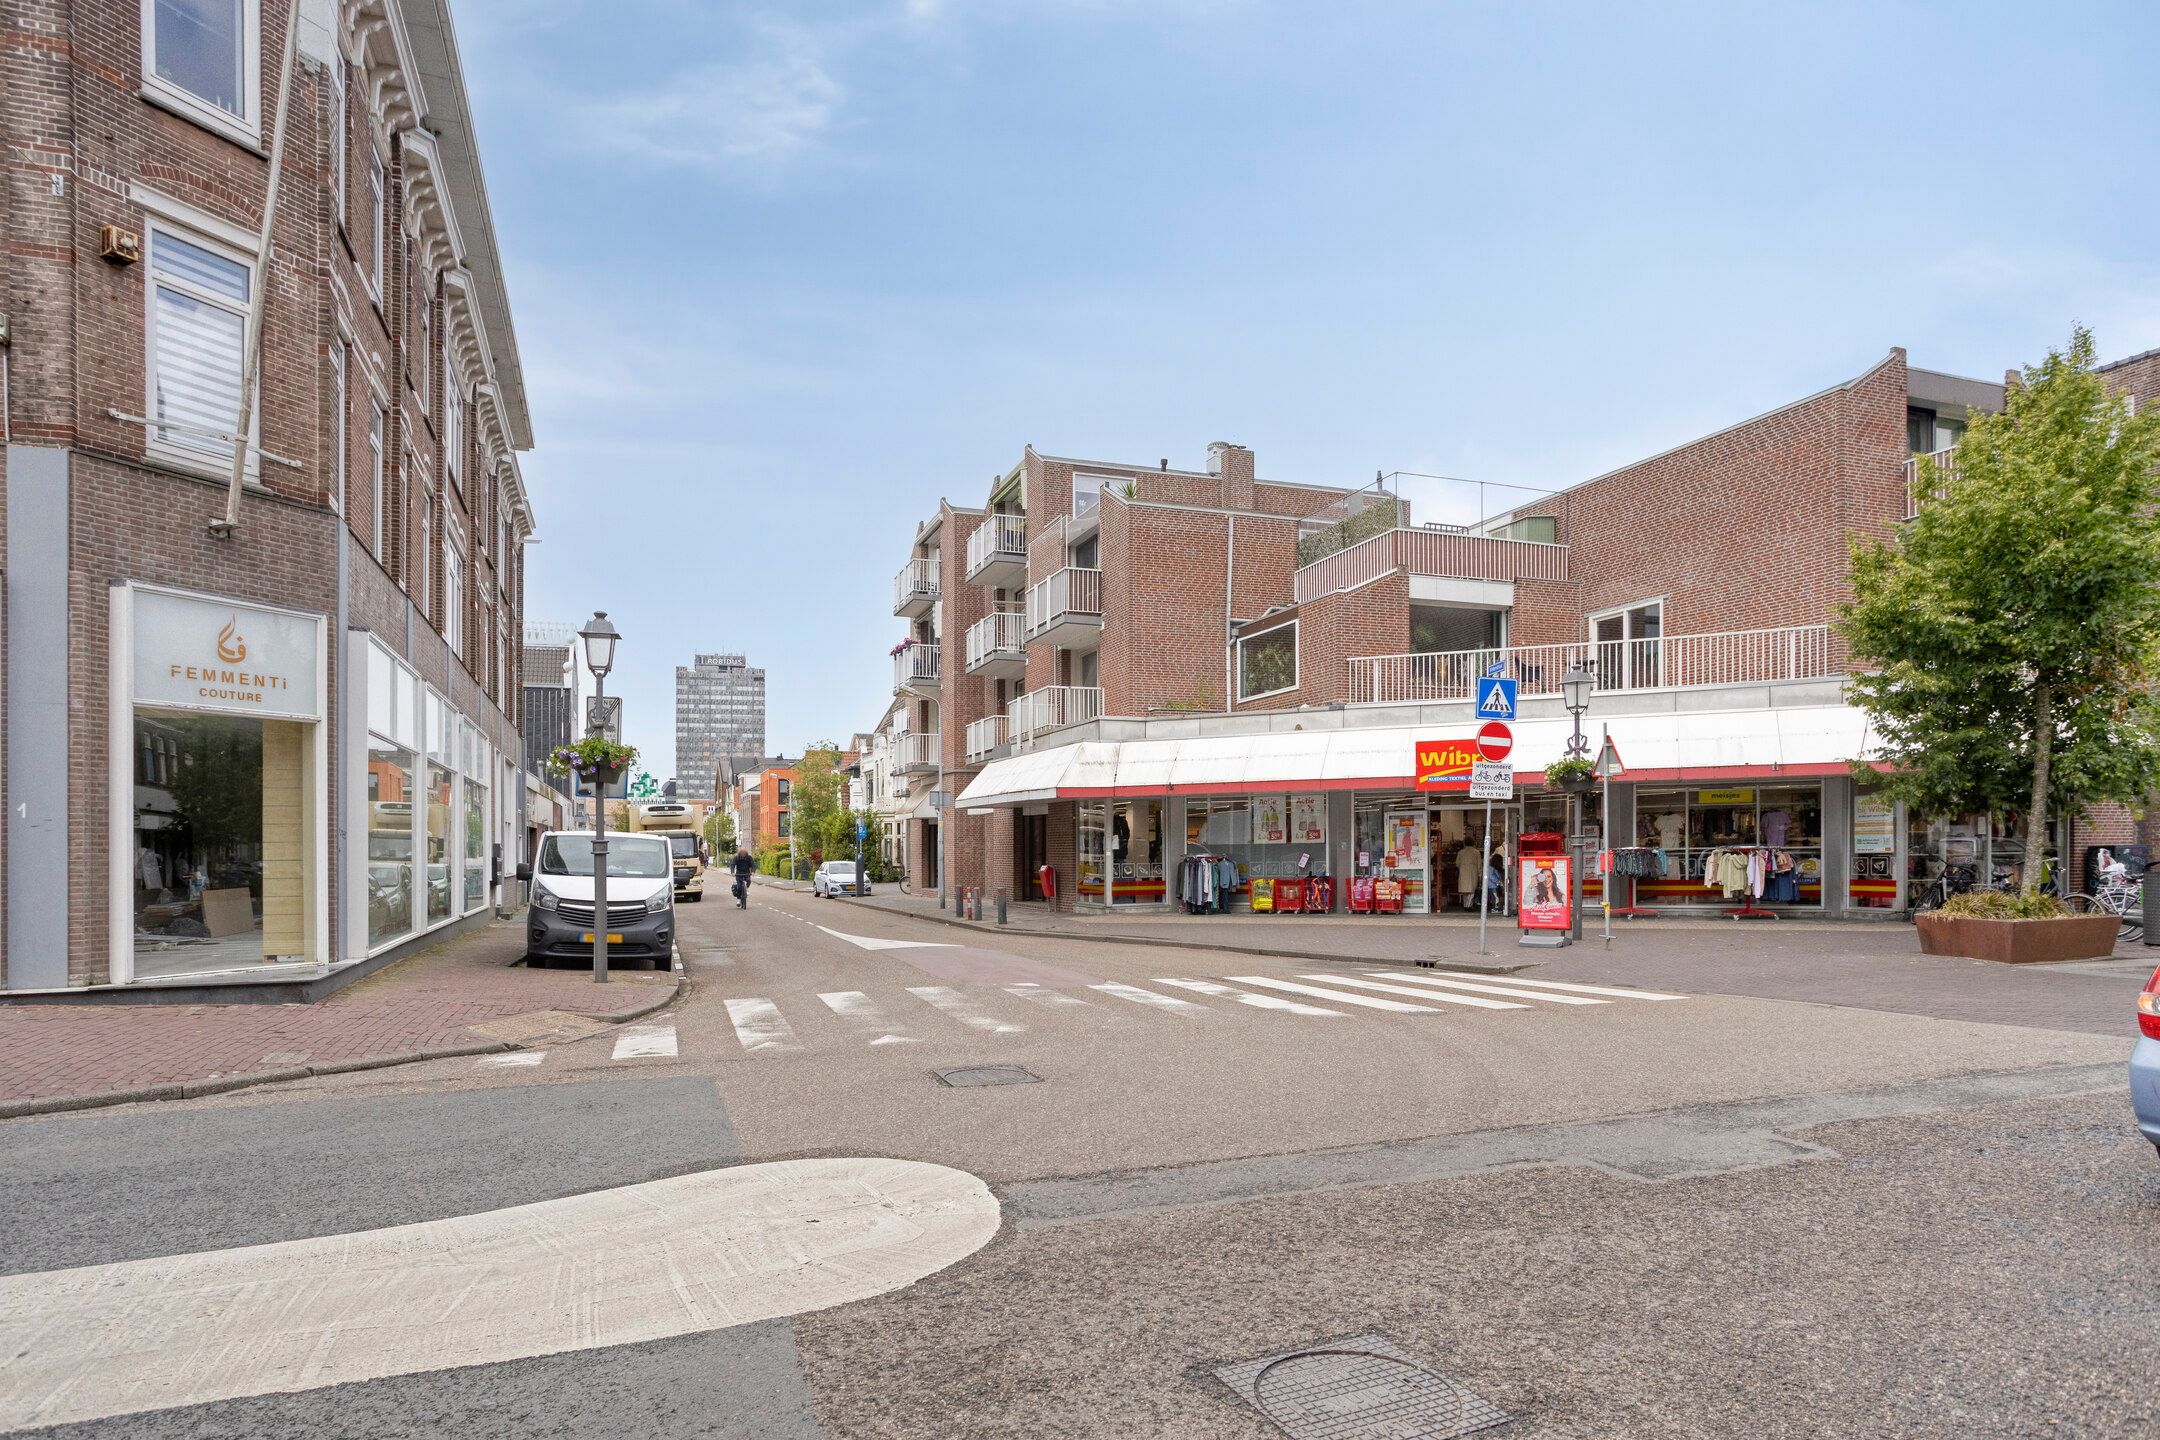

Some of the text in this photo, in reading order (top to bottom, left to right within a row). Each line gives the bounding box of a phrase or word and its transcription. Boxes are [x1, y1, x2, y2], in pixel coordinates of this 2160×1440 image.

[199, 687, 262, 703] COUTURE
[1420, 745, 1488, 767] Wibr
[1711, 791, 1740, 799] meisjes
[1363, 1414, 1436, 1438] WATER
